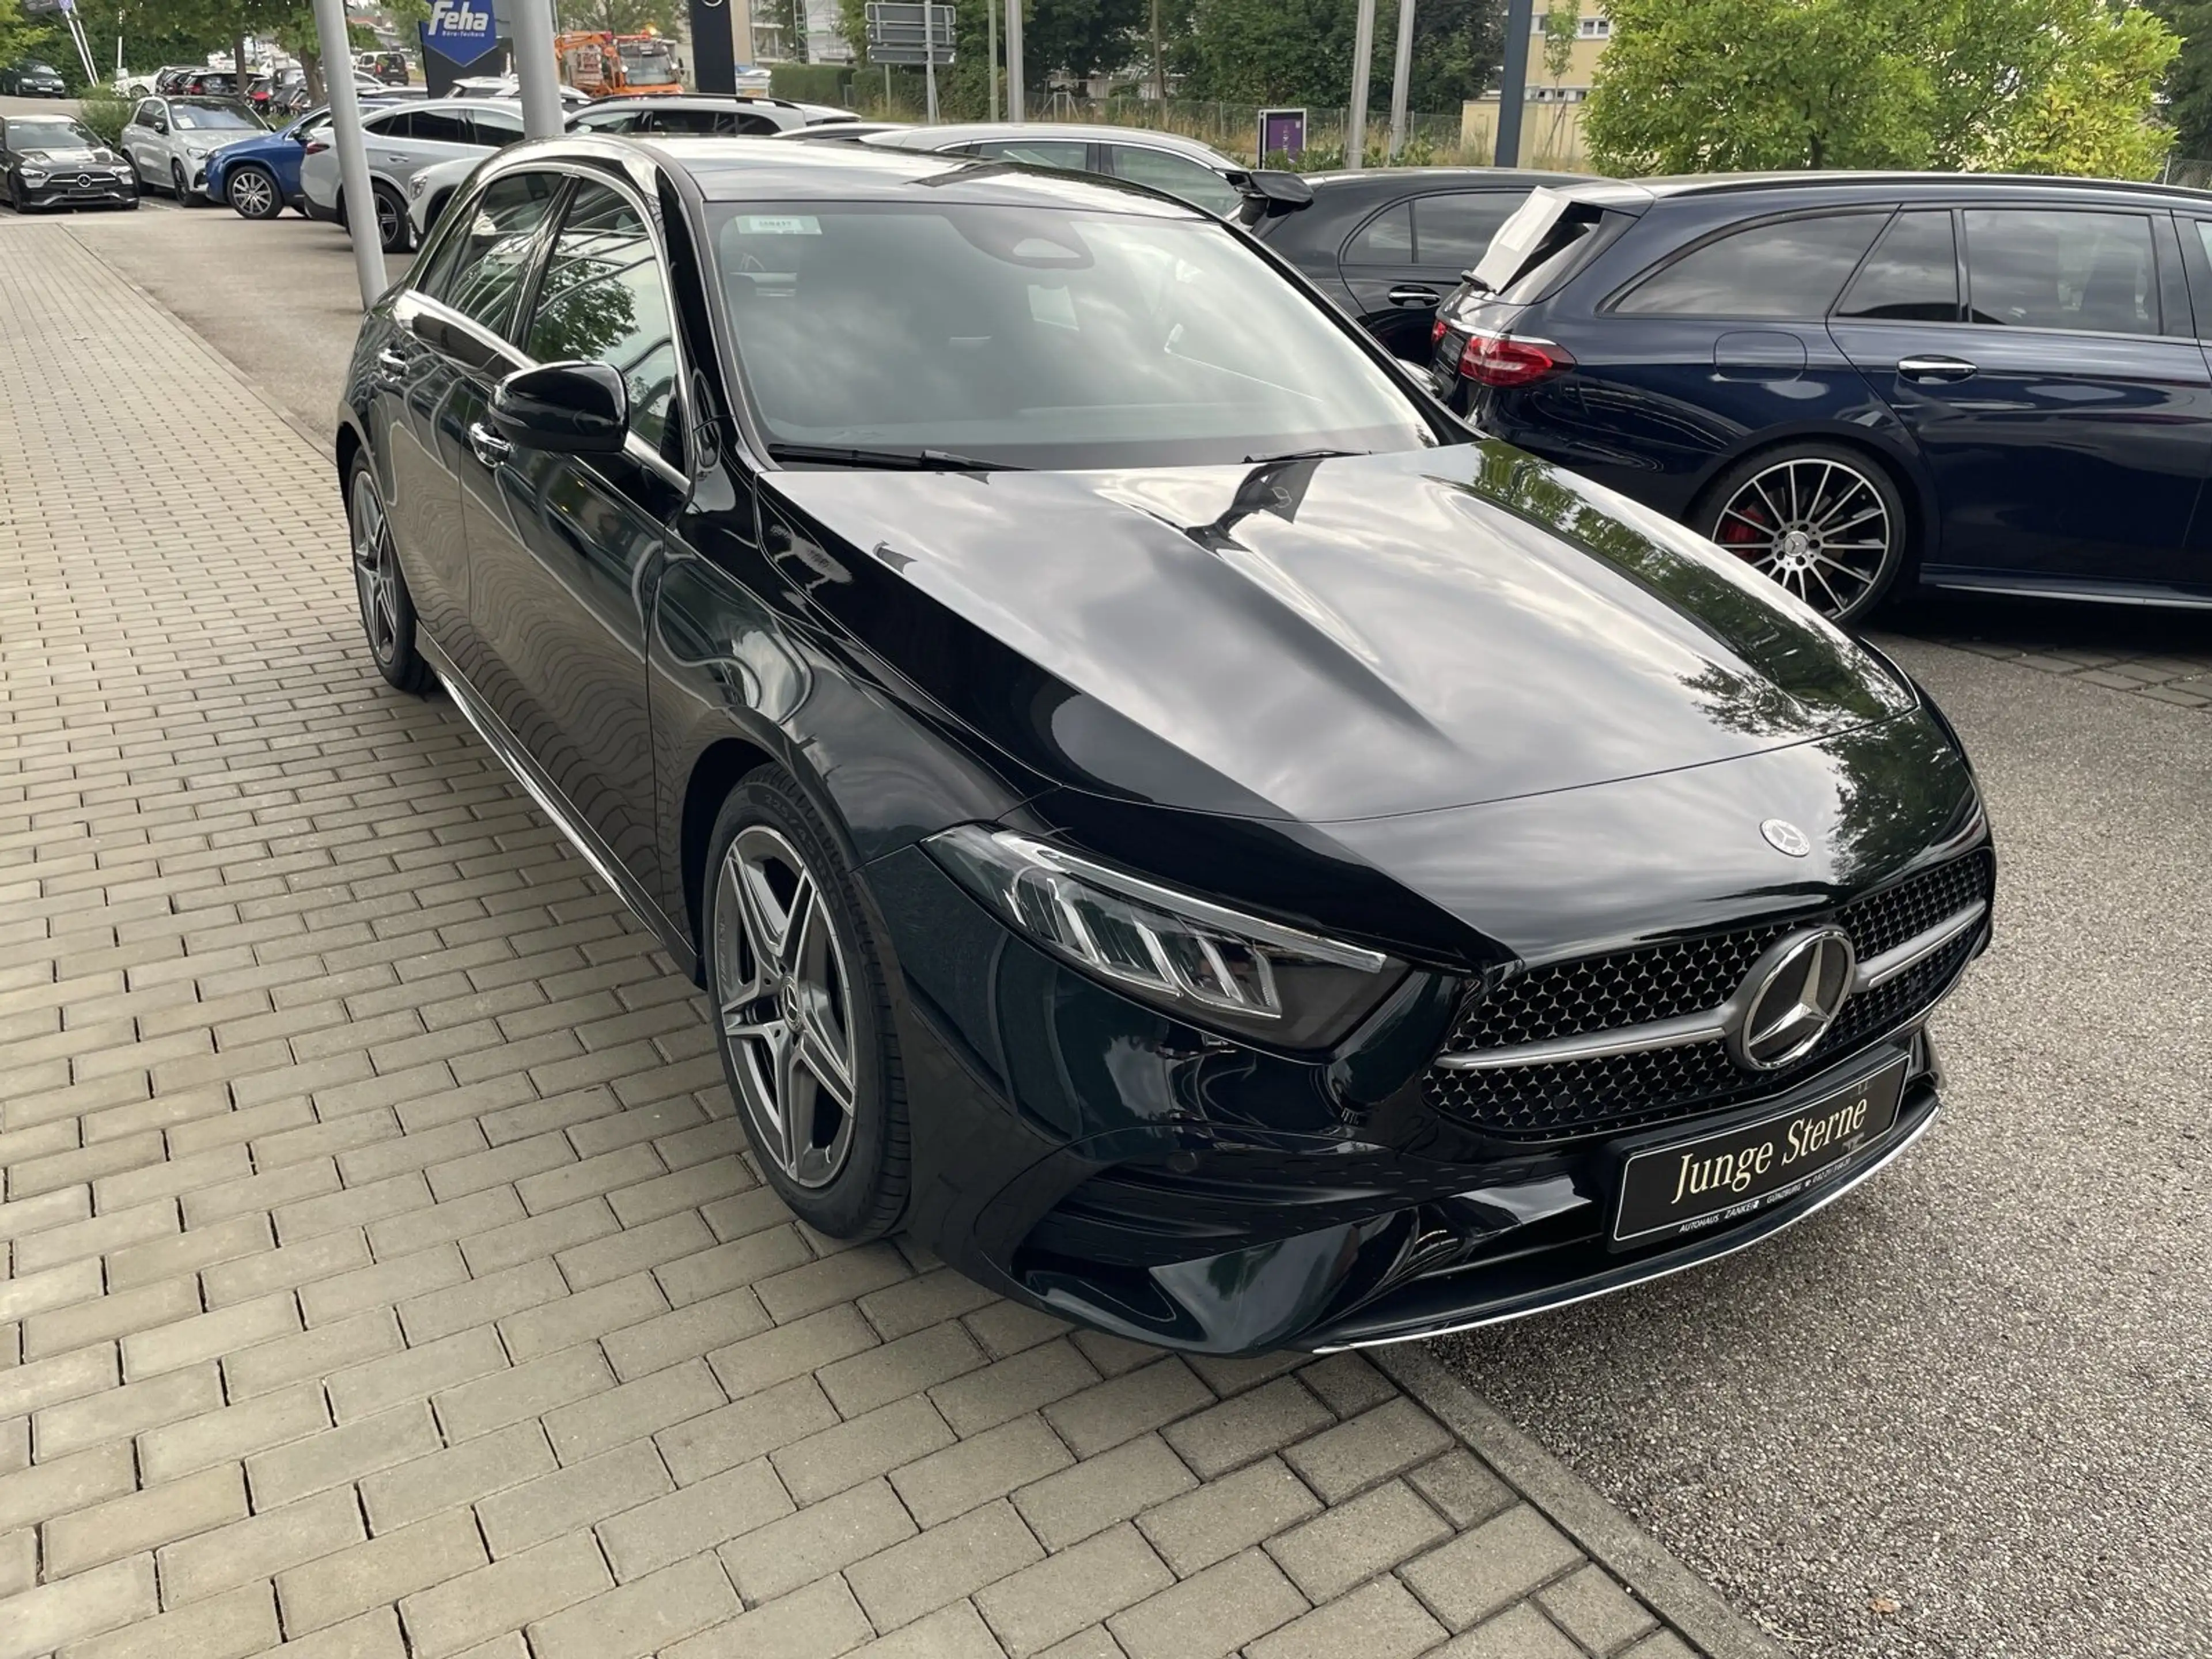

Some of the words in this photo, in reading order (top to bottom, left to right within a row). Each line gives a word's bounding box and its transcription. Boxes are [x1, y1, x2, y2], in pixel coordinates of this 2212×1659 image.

[428, 1, 489, 35] Feha
[1671, 1141, 1774, 1205] Junge
[1781, 1099, 1868, 1166] Sterne
[1679, 1214, 1719, 1233] AUTOHAUS
